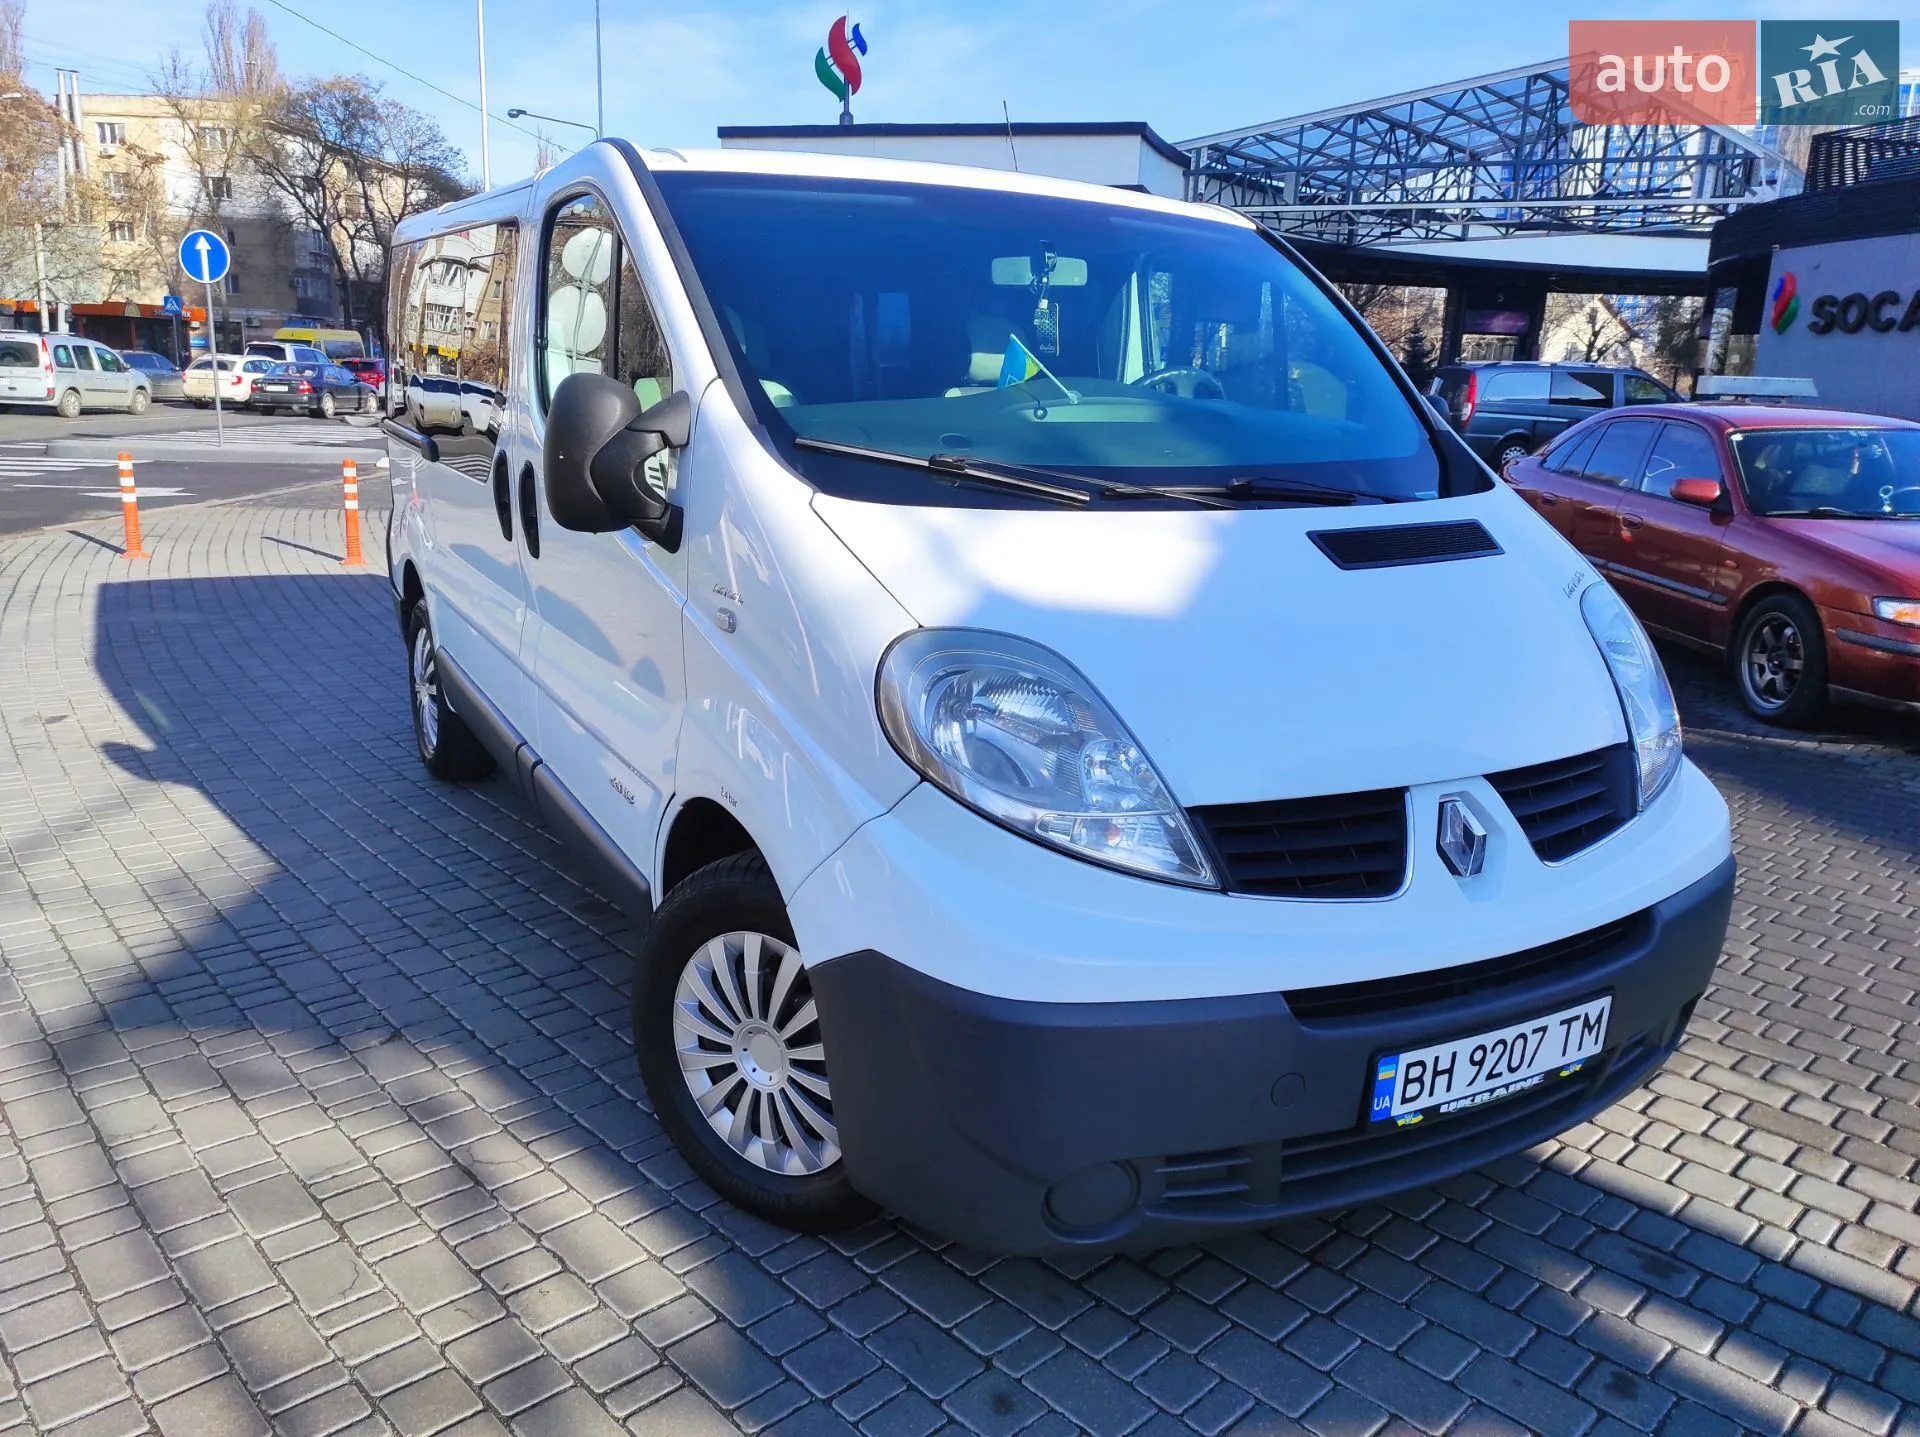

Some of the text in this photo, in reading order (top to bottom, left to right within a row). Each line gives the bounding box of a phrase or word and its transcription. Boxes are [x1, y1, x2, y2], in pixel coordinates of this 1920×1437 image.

[1400, 1006, 1605, 1106] BH 9207 TM
[1373, 1095, 1391, 1111] UA
